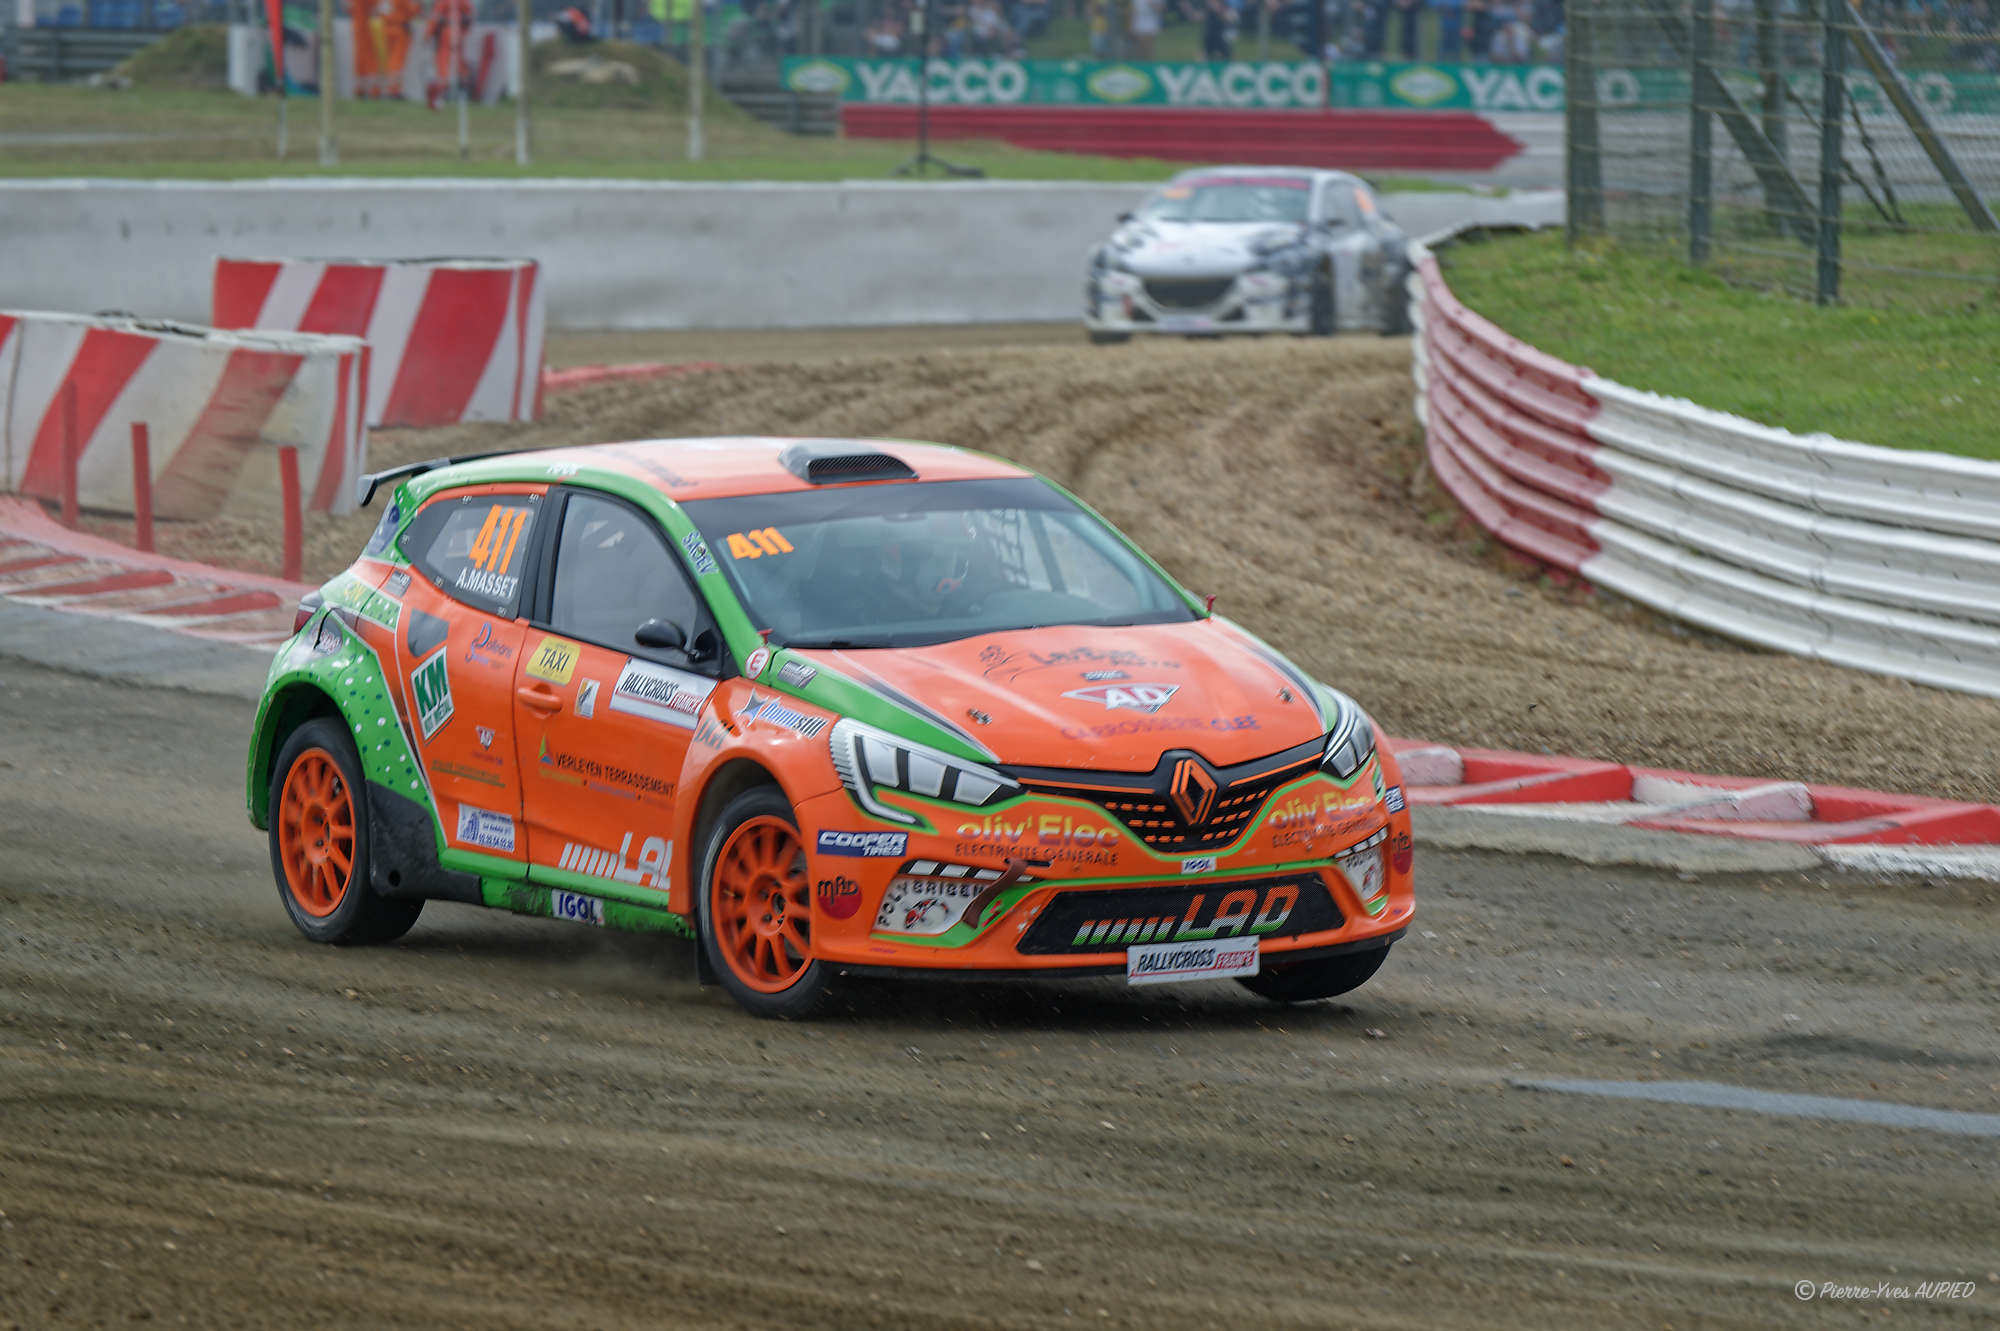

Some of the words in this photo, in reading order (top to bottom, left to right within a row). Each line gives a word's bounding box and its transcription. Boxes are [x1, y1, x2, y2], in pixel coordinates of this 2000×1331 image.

[855, 60, 1028, 102] YACCO
[1155, 63, 1326, 104] YACCO
[1460, 67, 1640, 107] YACO
[469, 504, 527, 574] 411
[726, 526, 794, 559] 411
[456, 567, 519, 599] A.MASSET
[539, 647, 570, 673] TAXI
[414, 654, 448, 719] KM
[620, 672, 680, 702] RALLYCROSS
[1105, 686, 1171, 710] AD
[605, 765, 675, 797] TERRASSEMENT
[819, 832, 907, 848] COOPER
[1039, 815, 1119, 847] Elec
[862, 846, 904, 857] TIRES
[1044, 847, 1118, 866] GENERALE
[558, 892, 596, 922] IGOL
[1173, 885, 1299, 940] LAD
[1137, 947, 1216, 972] RALLYCROSS
